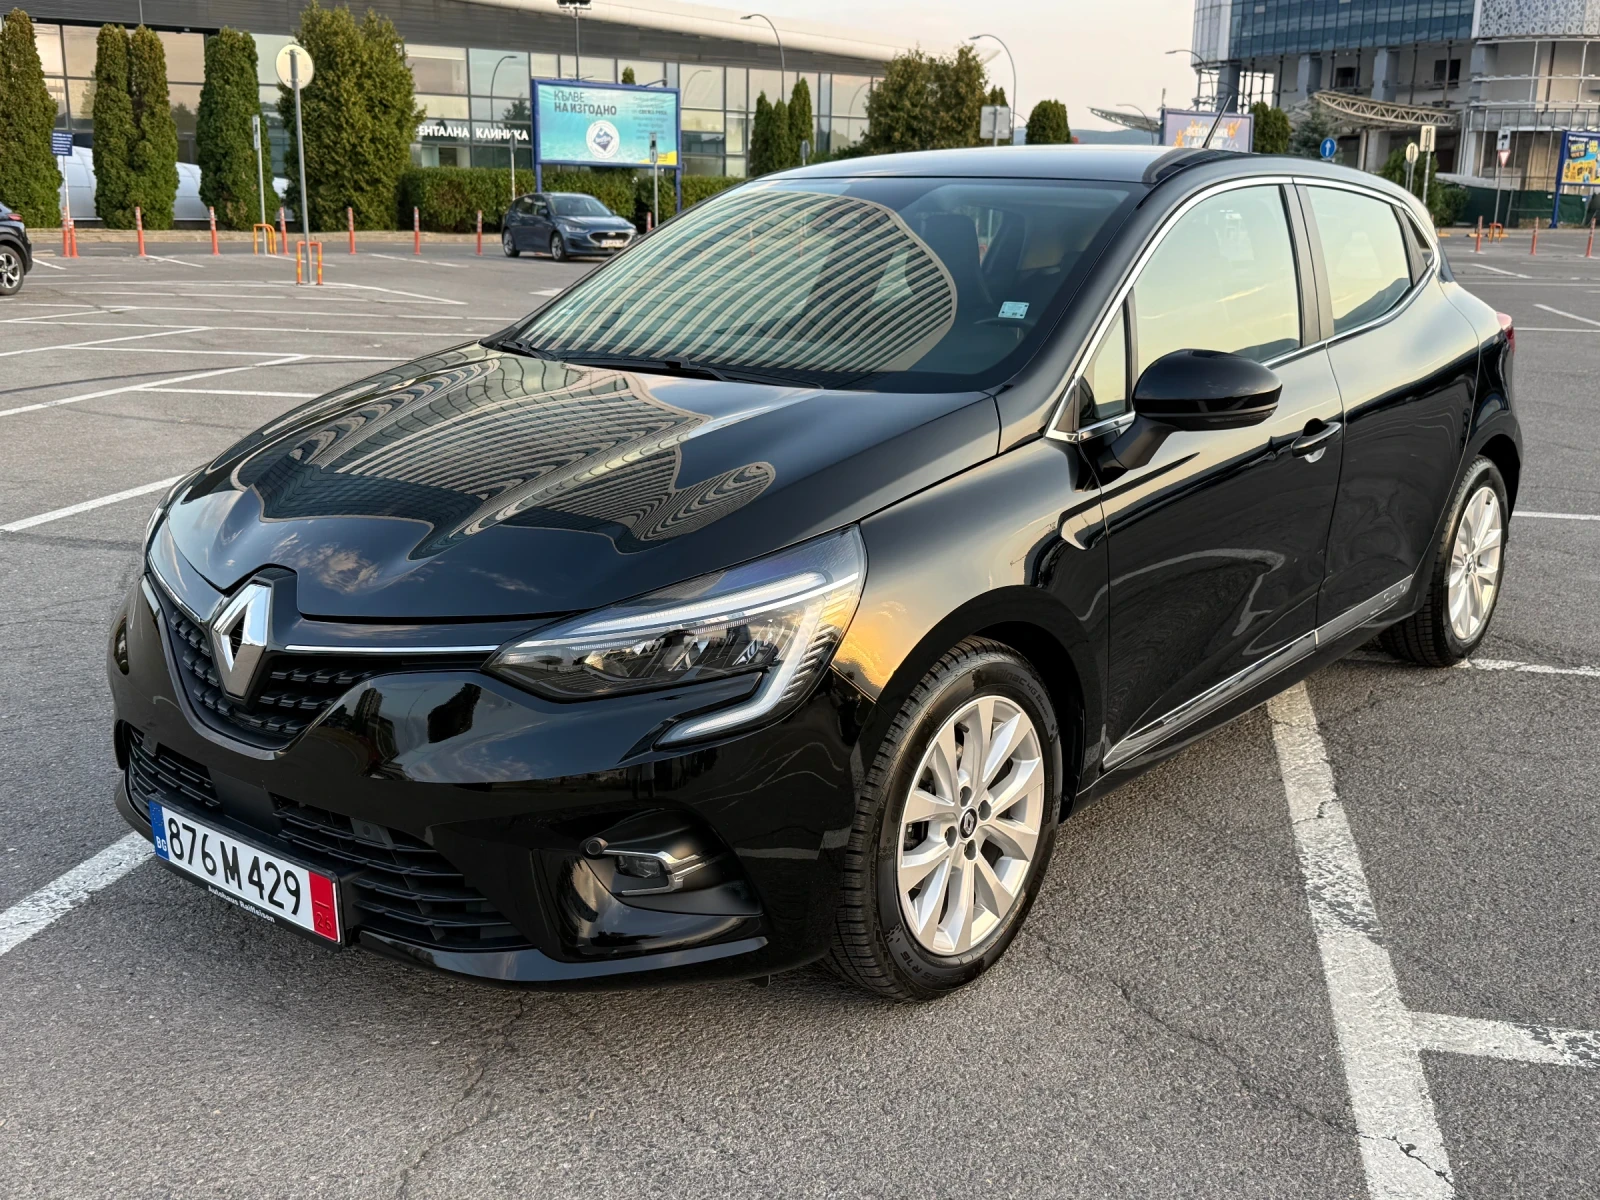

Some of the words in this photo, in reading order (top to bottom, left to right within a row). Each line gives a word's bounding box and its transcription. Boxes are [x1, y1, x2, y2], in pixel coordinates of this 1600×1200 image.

[554, 90, 585, 103] КЪЛВЕ
[554, 102, 569, 113] НА
[570, 103, 617, 117] ИЗГОДНО
[415, 125, 470, 138] ЕНТАЛНА
[475, 127, 529, 141] КЛИНИКА
[156, 835, 167, 852] BG
[316, 911, 332, 931] 26
